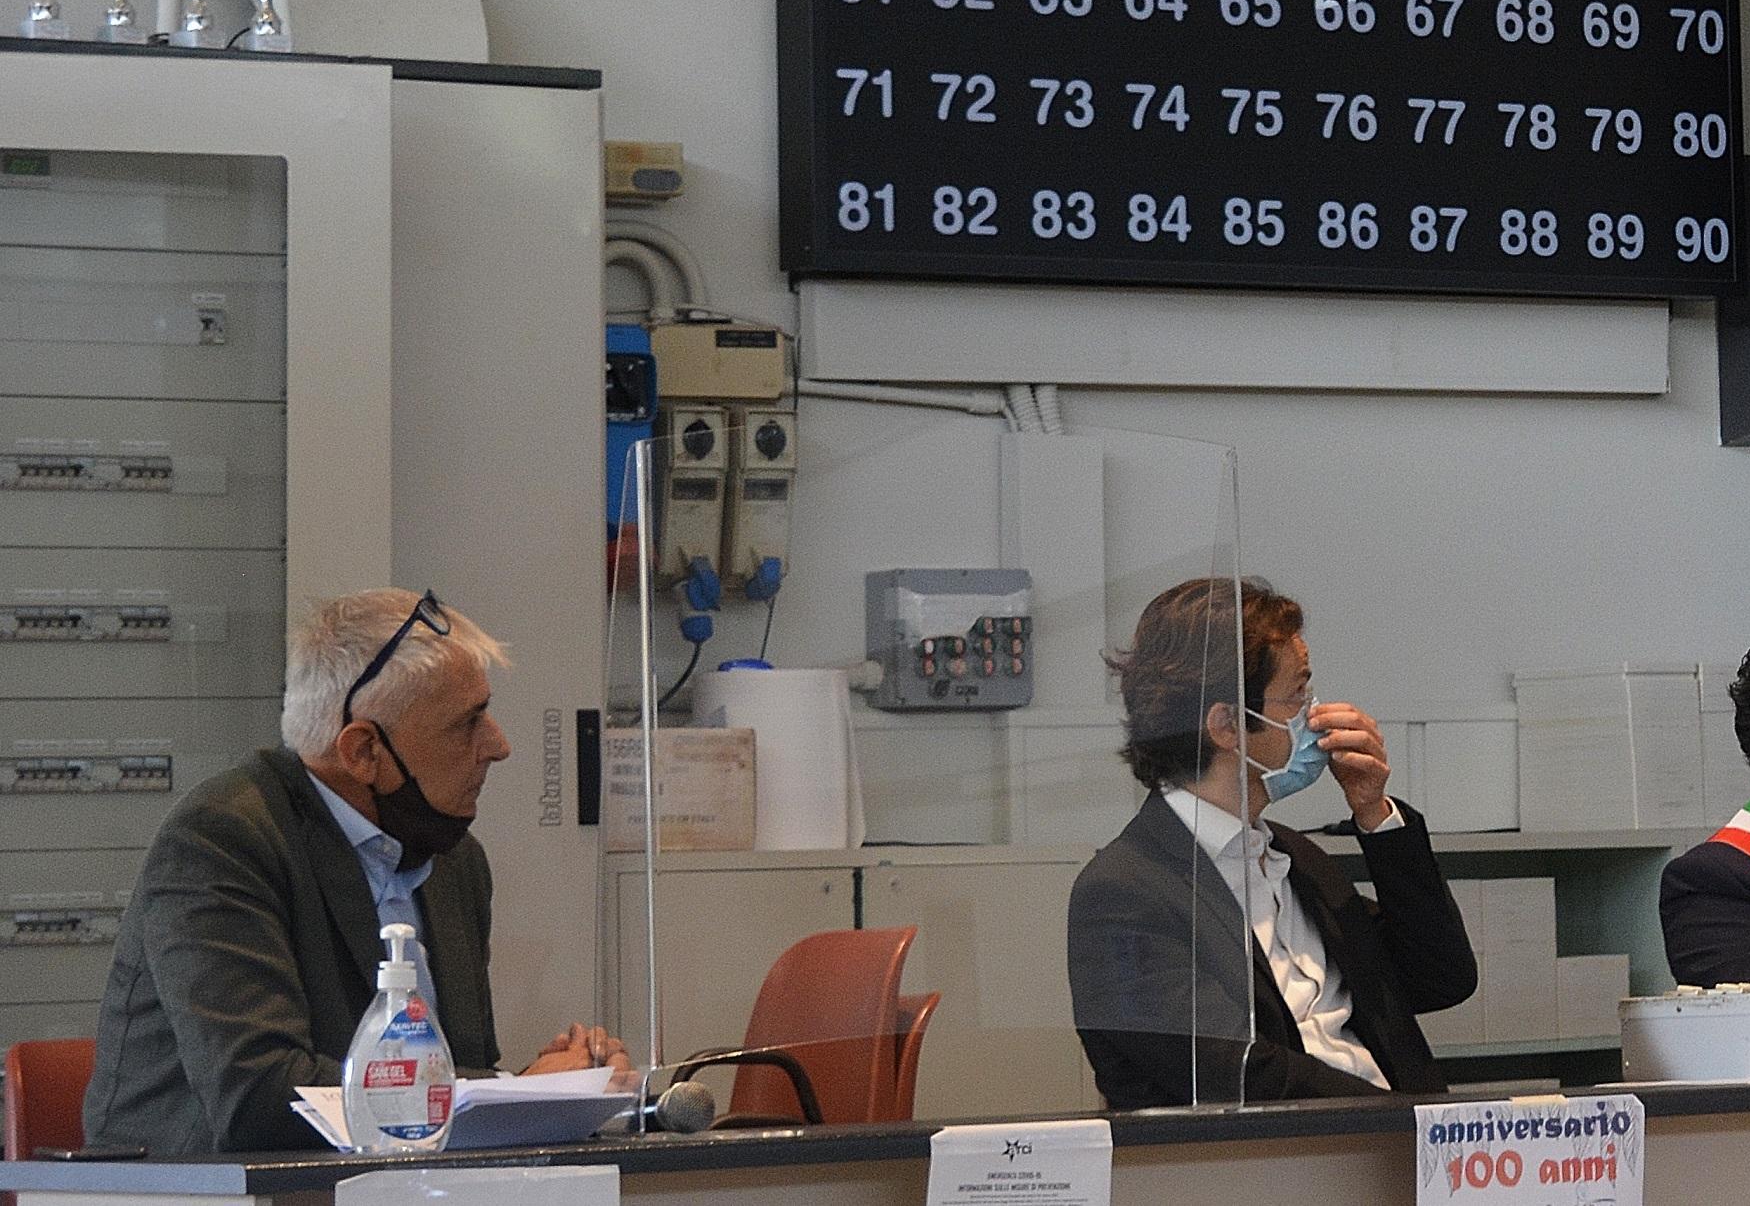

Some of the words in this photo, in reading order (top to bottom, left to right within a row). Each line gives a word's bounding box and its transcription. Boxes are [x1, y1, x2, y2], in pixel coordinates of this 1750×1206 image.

[1583, 1, 1640, 49] 69
[1669, 8, 1724, 54] 70
[836, 68, 893, 118] 71
[930, 73, 996, 123] 72
[1029, 78, 1094, 128] 73
[1125, 83, 1190, 132] 74
[1221, 88, 1283, 137] 75
[1315, 93, 1378, 142] 76
[1407, 98, 1466, 145] 77
[1497, 103, 1557, 150] 78
[1584, 107, 1642, 155] 79
[1673, 112, 1727, 158] 80
[838, 181, 895, 232] 81
[933, 185, 998, 235] 82
[1032, 189, 1096, 240] 83
[1127, 193, 1192, 243] 84
[1223, 197, 1285, 246] 85
[1318, 201, 1379, 250] 86
[1409, 205, 1468, 252] 87
[1500, 208, 1559, 257] 88
[1587, 212, 1644, 260] 89
[1675, 216, 1729, 263] 90
[1429, 1101, 1632, 1144] anniversario
[1448, 1149, 1524, 1192] 100
[1538, 1143, 1617, 1184] anni
